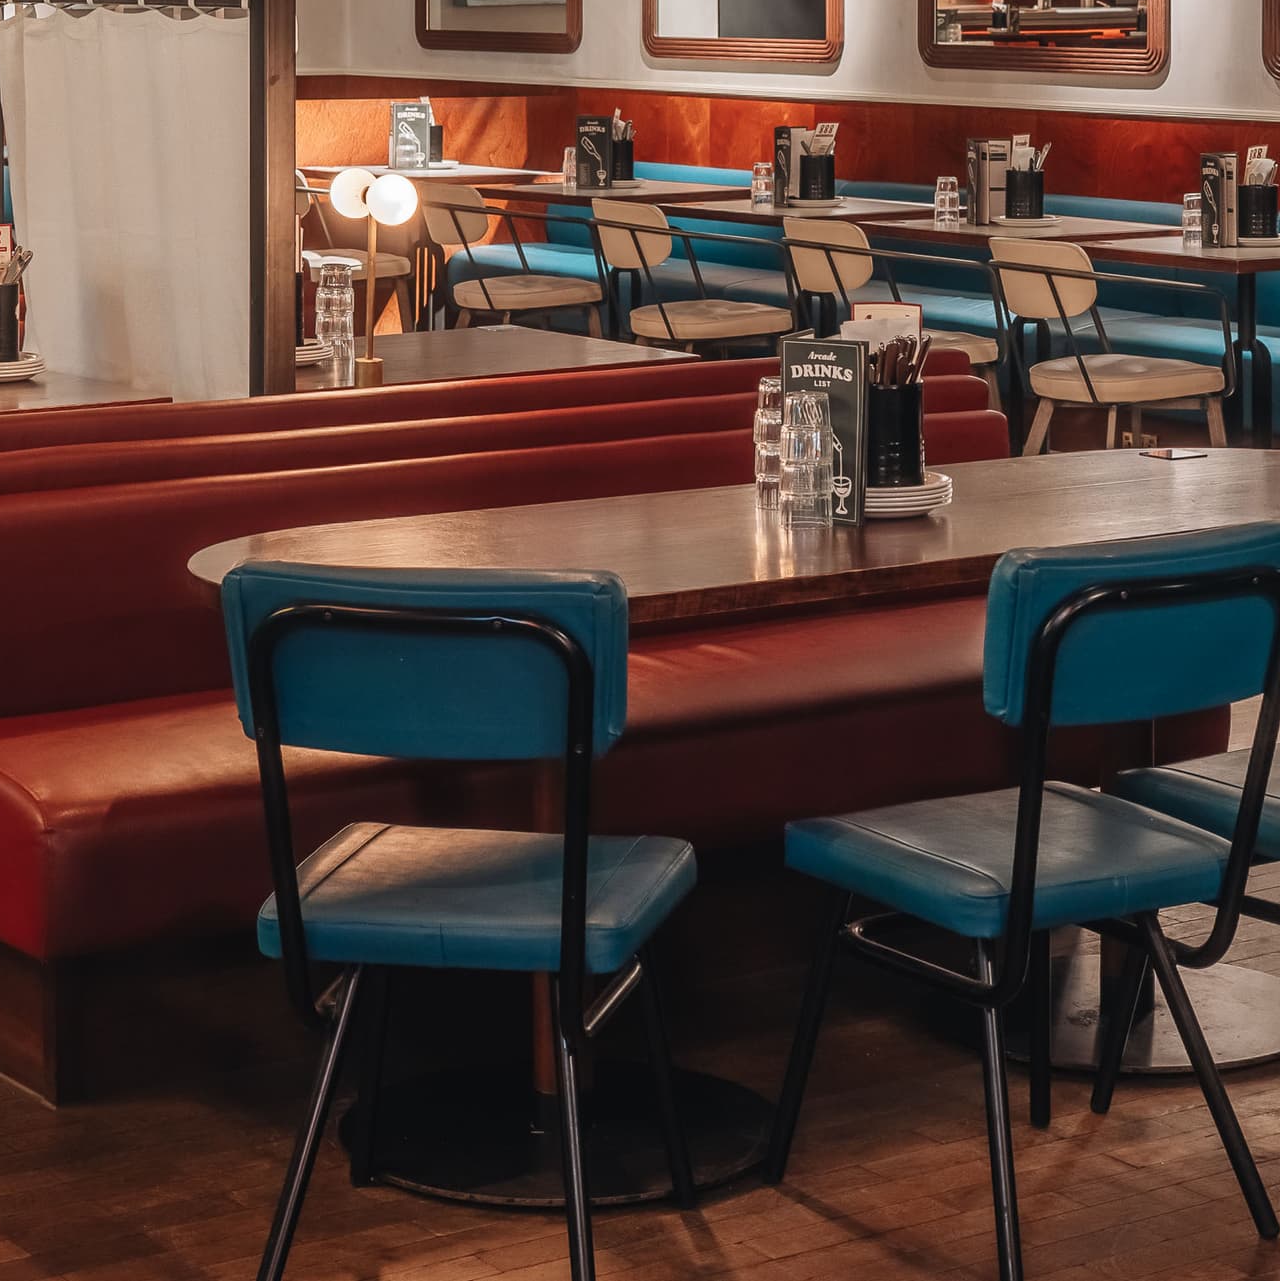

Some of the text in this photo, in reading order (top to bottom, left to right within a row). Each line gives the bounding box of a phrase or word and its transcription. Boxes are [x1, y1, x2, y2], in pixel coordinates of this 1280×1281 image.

[807, 351, 837, 362] Arcade
[790, 363, 854, 383] DRINKS
[813, 380, 831, 388] LIST
